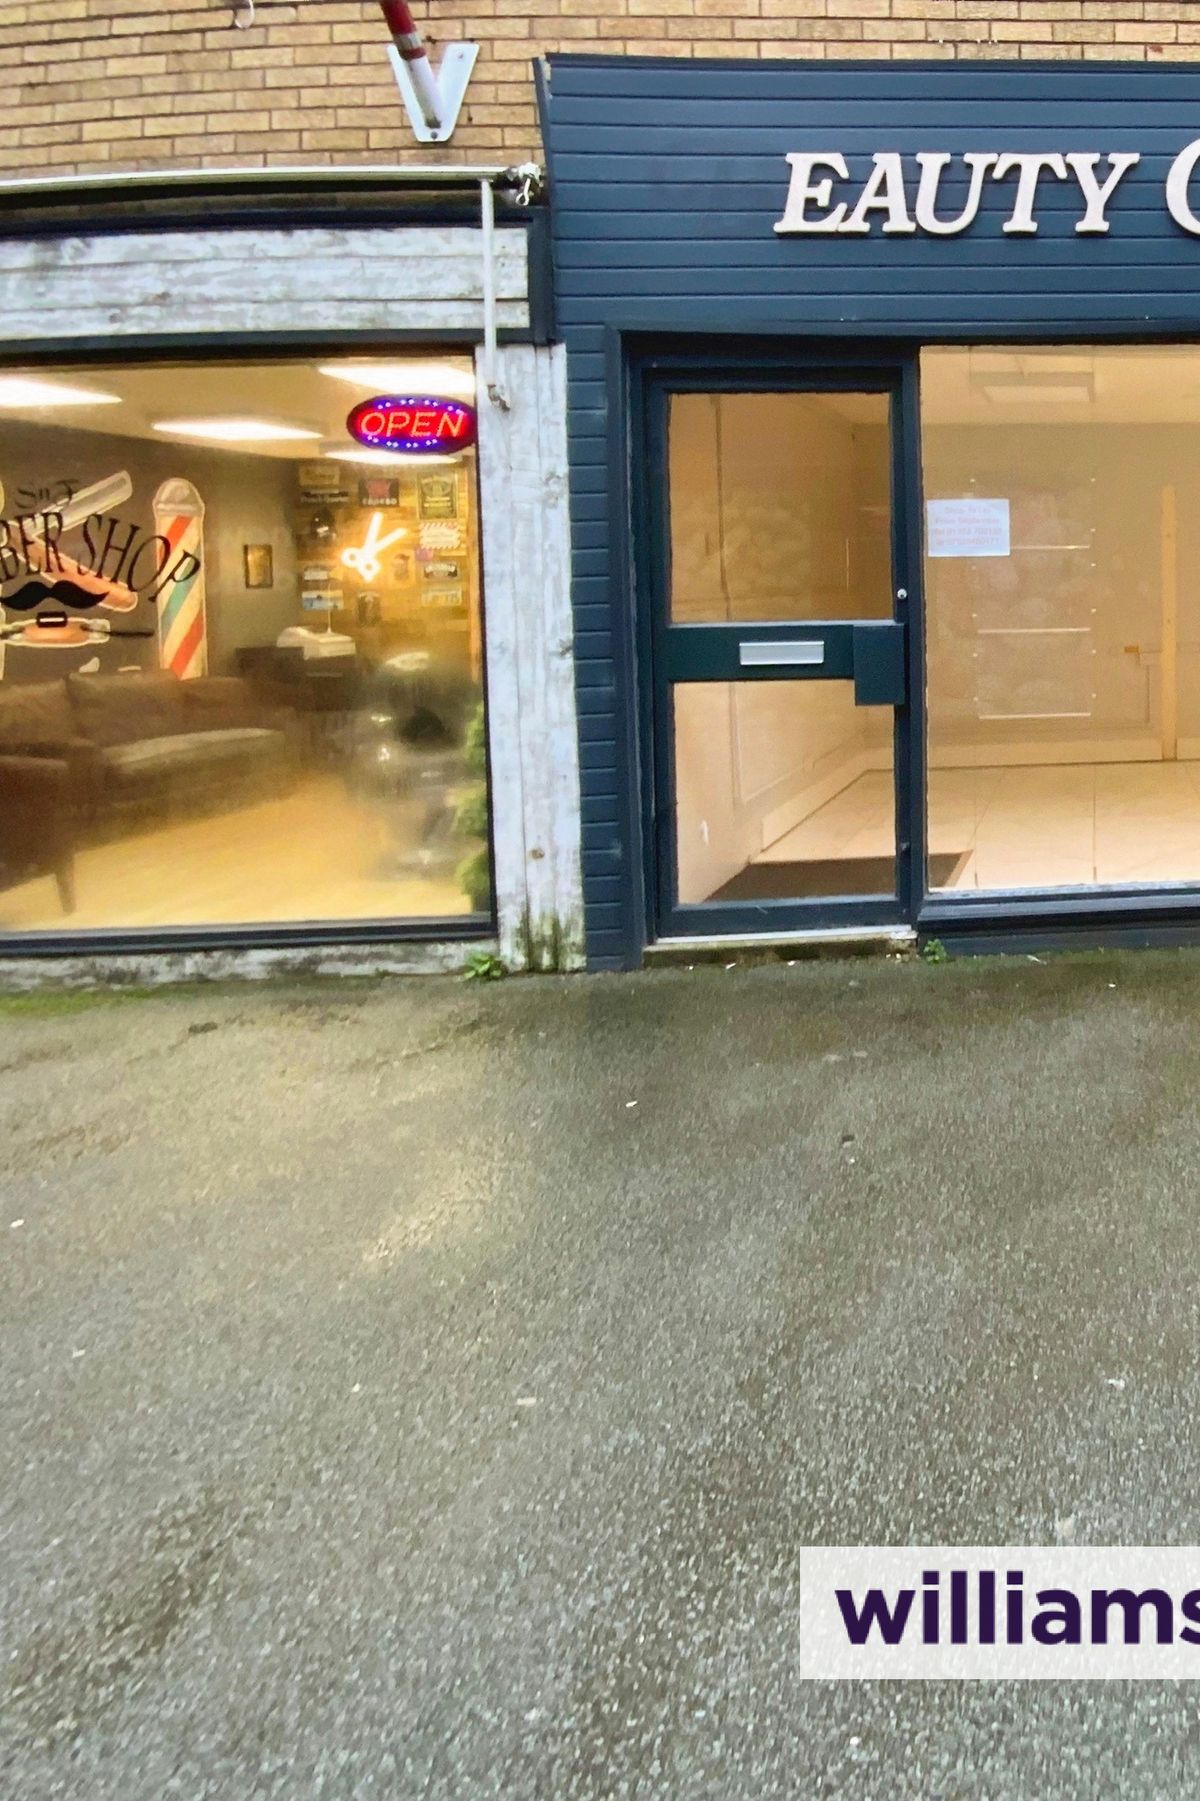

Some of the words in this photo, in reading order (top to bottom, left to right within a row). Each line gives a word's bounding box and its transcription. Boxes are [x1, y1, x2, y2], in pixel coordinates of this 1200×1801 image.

[774, 151, 1139, 234] EAUTY
[361, 411, 464, 436] OPEN
[77, 513, 201, 603] SHOP
